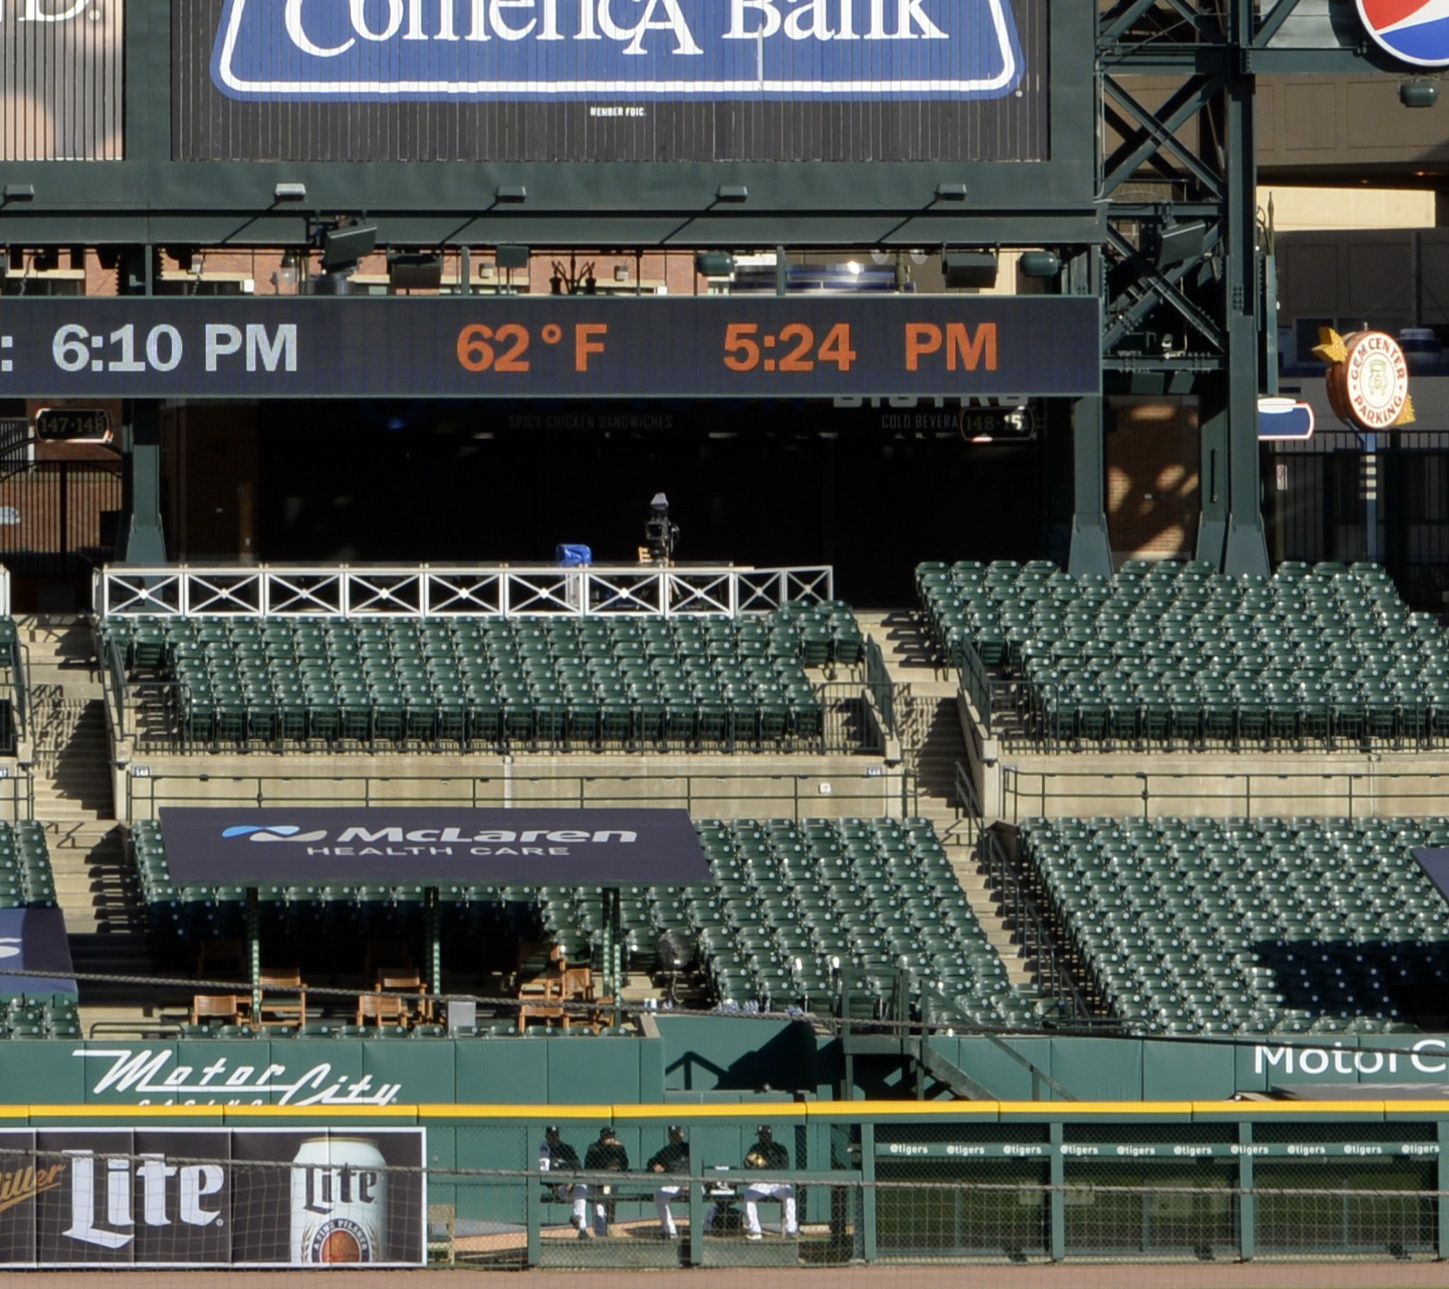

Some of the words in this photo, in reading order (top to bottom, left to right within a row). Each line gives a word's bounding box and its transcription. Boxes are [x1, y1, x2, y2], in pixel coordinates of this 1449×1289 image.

[51, 322, 183, 374] 6:10
[205, 323, 298, 373] PM
[722, 322, 857, 373] 5:24
[904, 322, 998, 373] PM
[1351, 345, 1369, 380] GEM
[1368, 337, 1405, 380] CENTER
[508, 414, 542, 430] SPICY
[545, 414, 596, 430] CHICKEN
[599, 414, 672, 430] SANDWICHES
[881, 414, 911, 430] COLD
[1354, 394, 1403, 425] PARKING
[336, 826, 637, 843] McLaren
[306, 846, 454, 856] HEALTH
[470, 846, 571, 856] CARE
[890, 1143, 928, 1155] @tigers
[946, 1144, 984, 1156] @tigers
[1003, 1143, 1041, 1155] @tigers
[1060, 1143, 1098, 1155] @tigers
[1117, 1144, 1155, 1156] @tigers
[1174, 1144, 1212, 1156] @tigers
[1231, 1143, 1269, 1155] @tigers
[1287, 1143, 1325, 1155] @tigers
[1344, 1143, 1382, 1155] @tigers
[1402, 1142, 1440, 1154] @tigers
[61, 1149, 225, 1250] Lite
[302, 1166, 379, 1215] Lite
[337, 1218, 368, 1251] PILSNER
